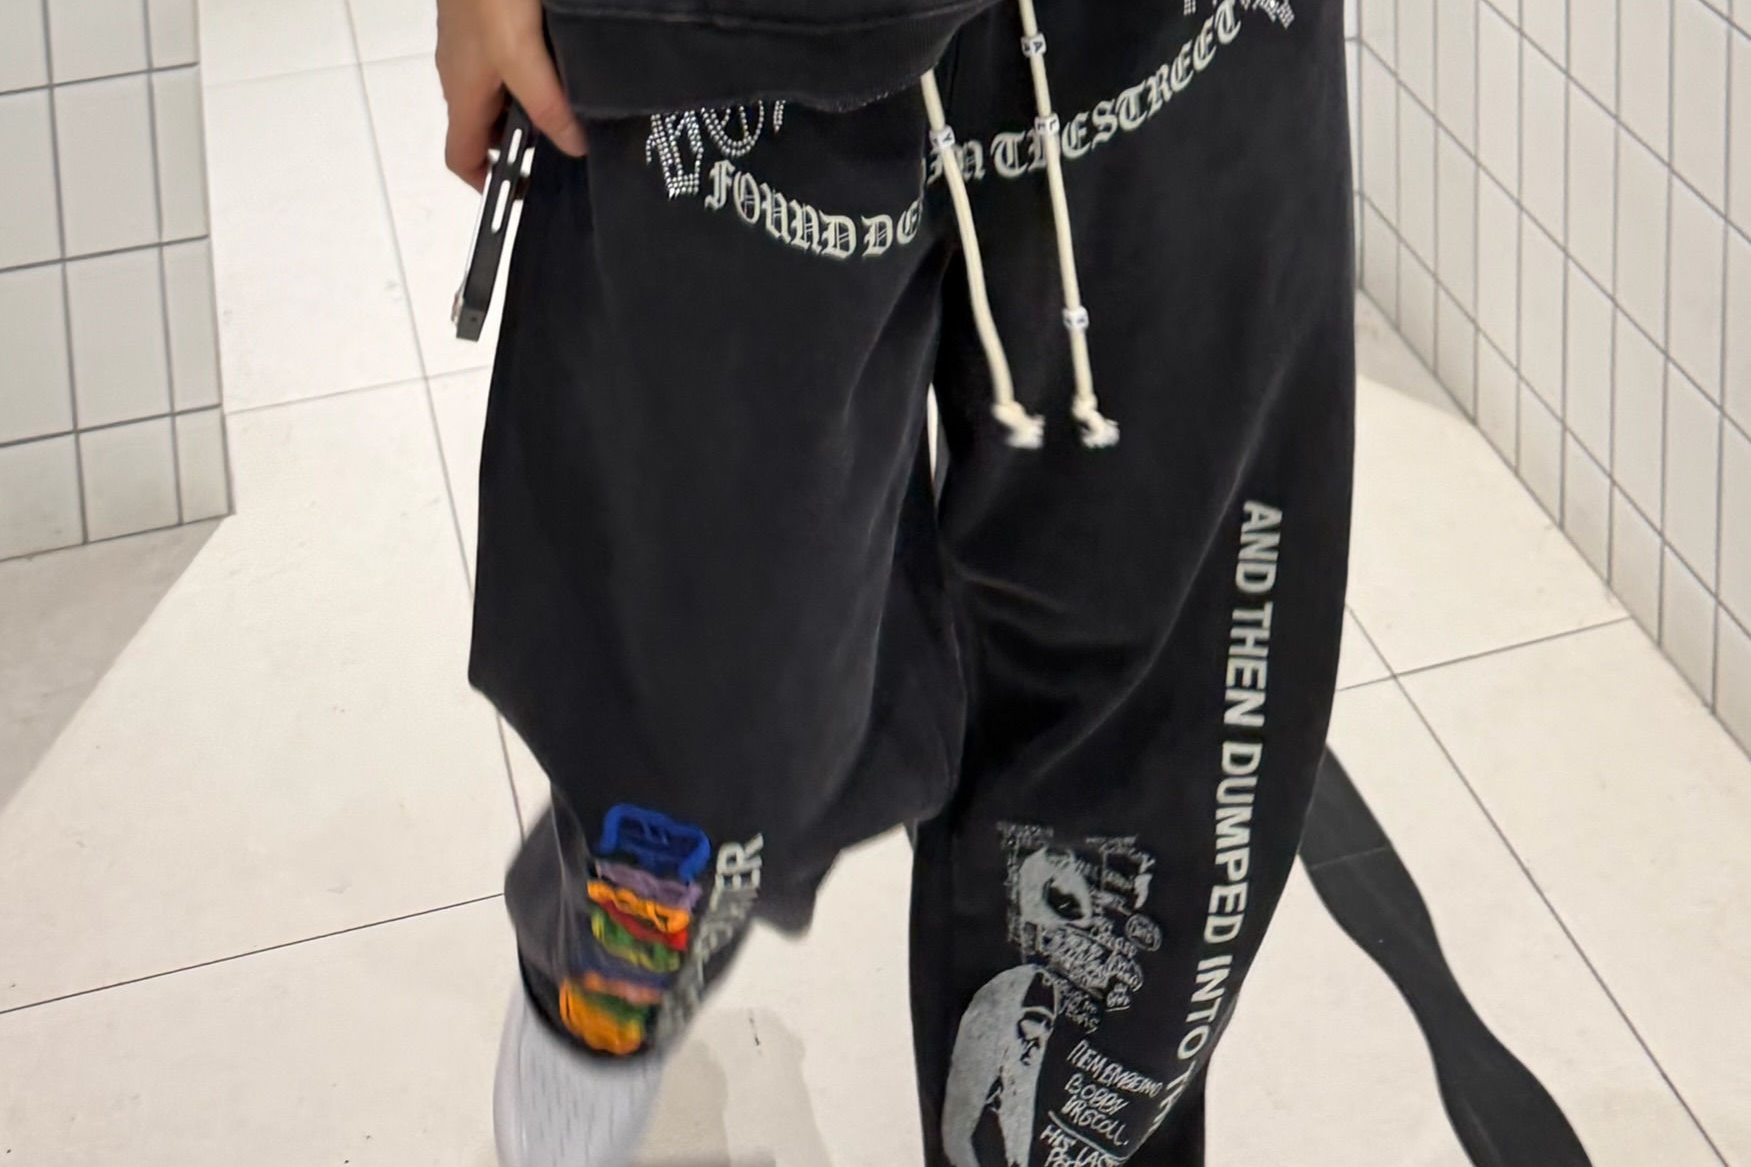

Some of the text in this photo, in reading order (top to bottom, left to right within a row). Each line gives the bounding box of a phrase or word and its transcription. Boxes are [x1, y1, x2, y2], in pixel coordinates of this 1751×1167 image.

[704, 159, 857, 259] FOUND
[1177, 499, 1283, 1061] AND THEN DUMPED INTO
